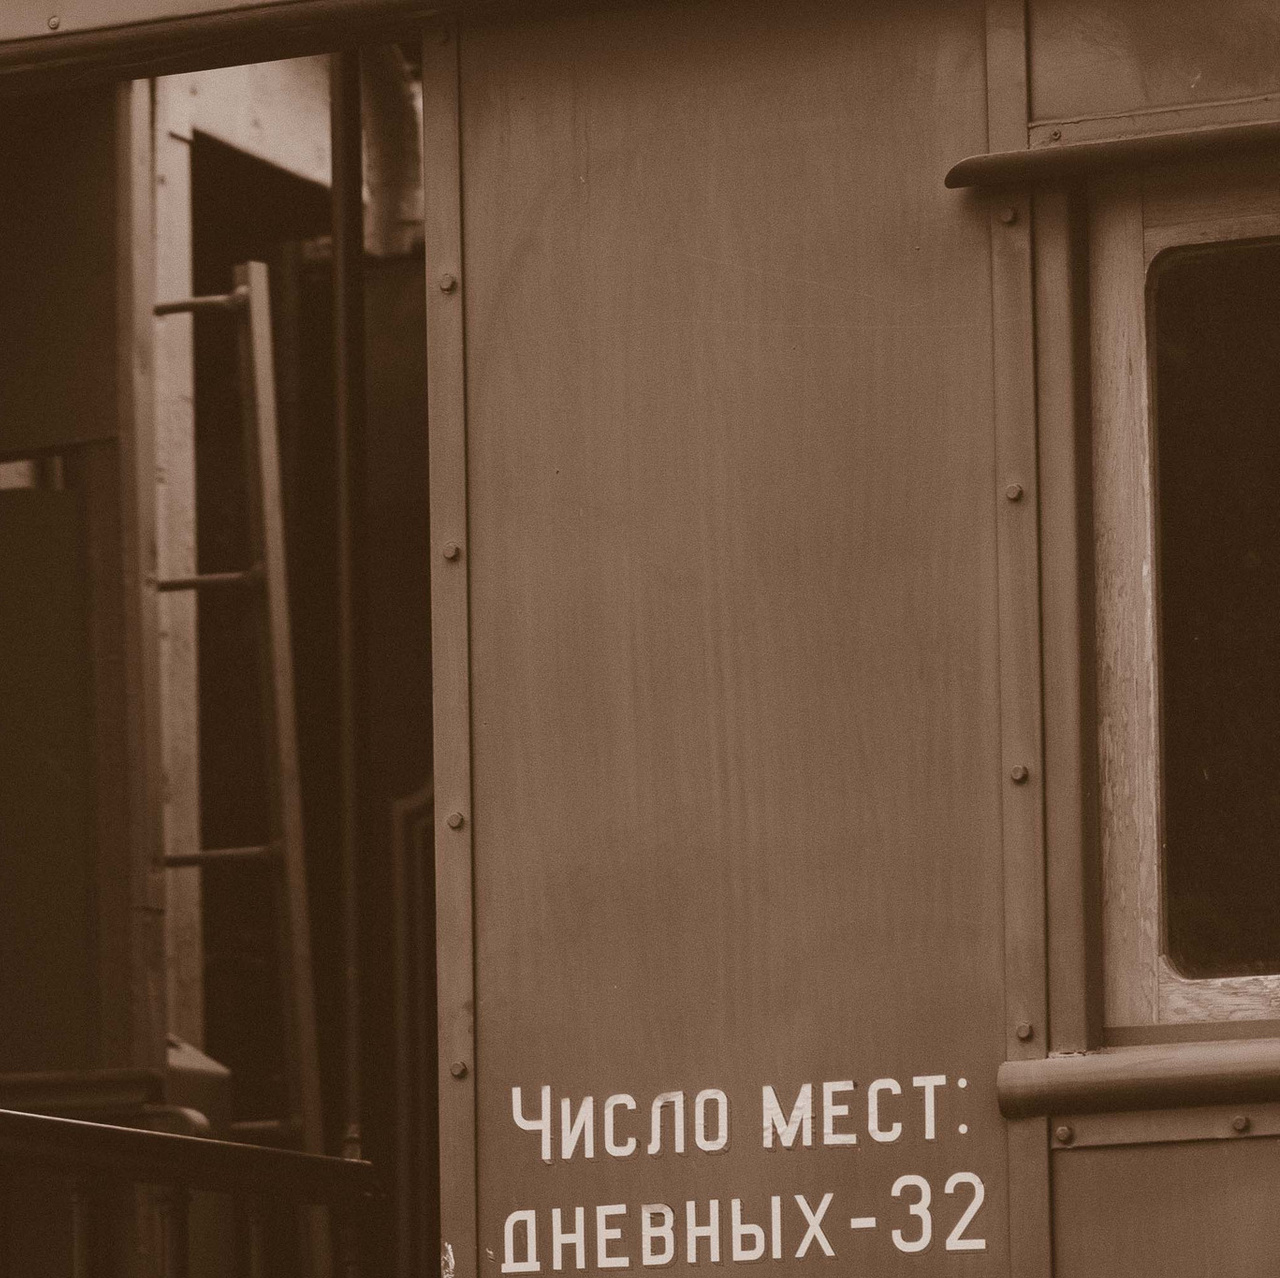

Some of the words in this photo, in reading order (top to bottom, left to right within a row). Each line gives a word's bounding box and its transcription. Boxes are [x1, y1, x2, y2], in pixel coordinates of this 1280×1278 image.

[511, 1085, 729, 1161] ЧИСЛО
[762, 1074, 969, 1149] МЕСТ:
[501, 1171, 987, 1274] ДНЕВНЫХ-32
